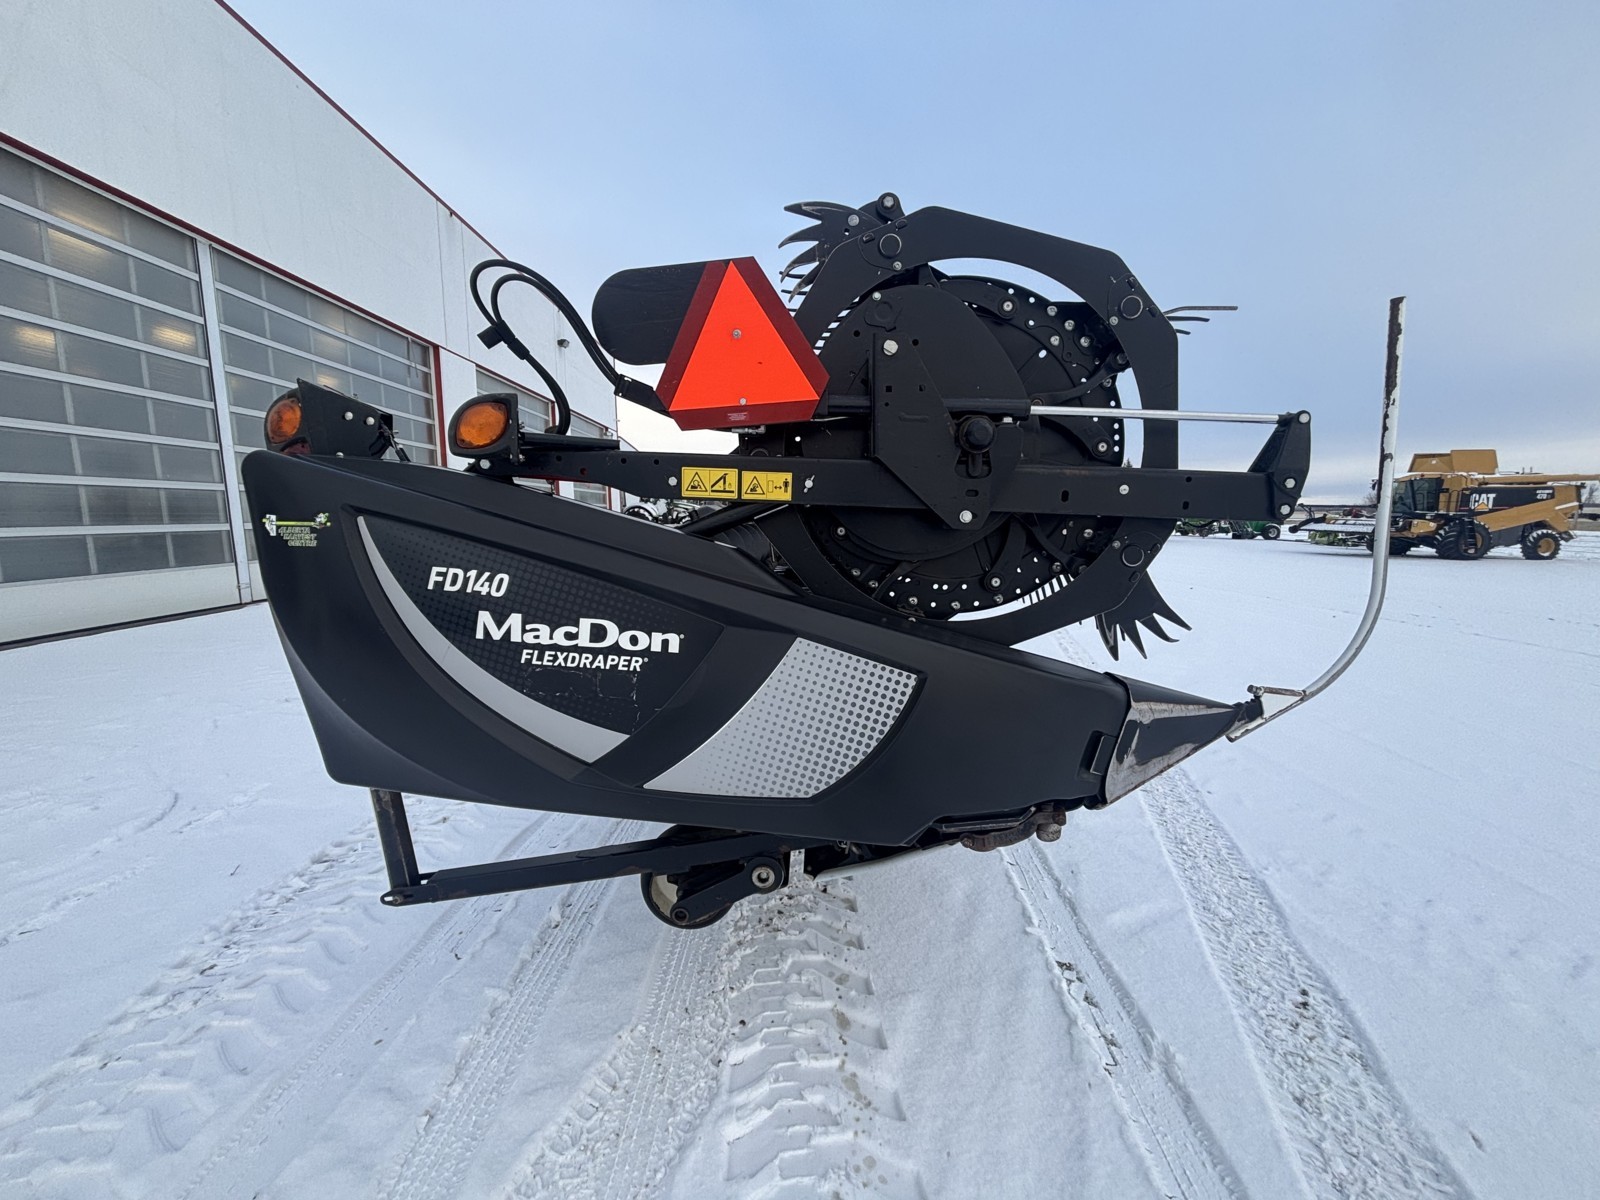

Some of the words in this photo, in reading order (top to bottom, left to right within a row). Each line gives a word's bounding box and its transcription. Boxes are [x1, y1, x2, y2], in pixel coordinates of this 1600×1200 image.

[1469, 493, 1496, 510] CAT
[427, 566, 510, 598] FD140
[475, 610, 681, 654] MacDon
[520, 649, 644, 672] FLEXDRAPER
